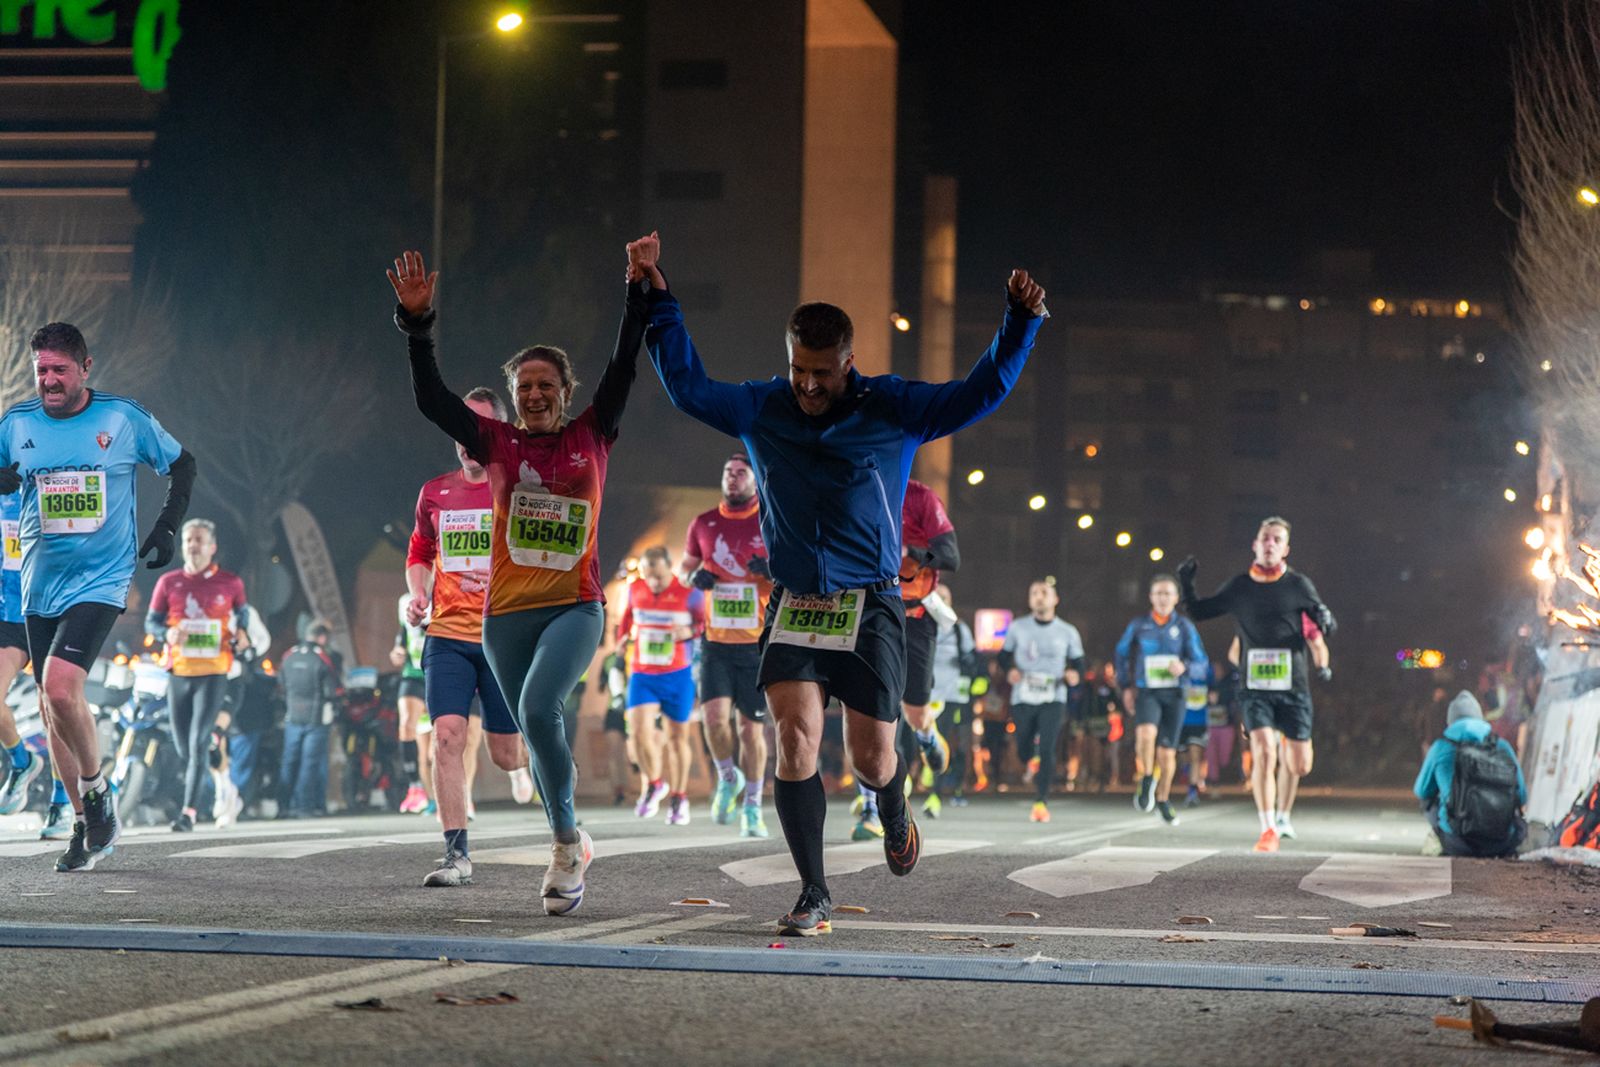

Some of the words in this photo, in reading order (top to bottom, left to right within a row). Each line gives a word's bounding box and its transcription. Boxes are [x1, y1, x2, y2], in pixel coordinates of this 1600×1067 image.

[45, 493, 98, 512] 13665
[527, 501, 553, 510] NOCHE
[553, 503, 562, 512] DE
[517, 508, 534, 518] SAN
[446, 531, 490, 550] 12709
[518, 518, 579, 547] 13544
[718, 600, 750, 614] 12312
[789, 600, 805, 609] SAN
[789, 609, 848, 630] 13819
